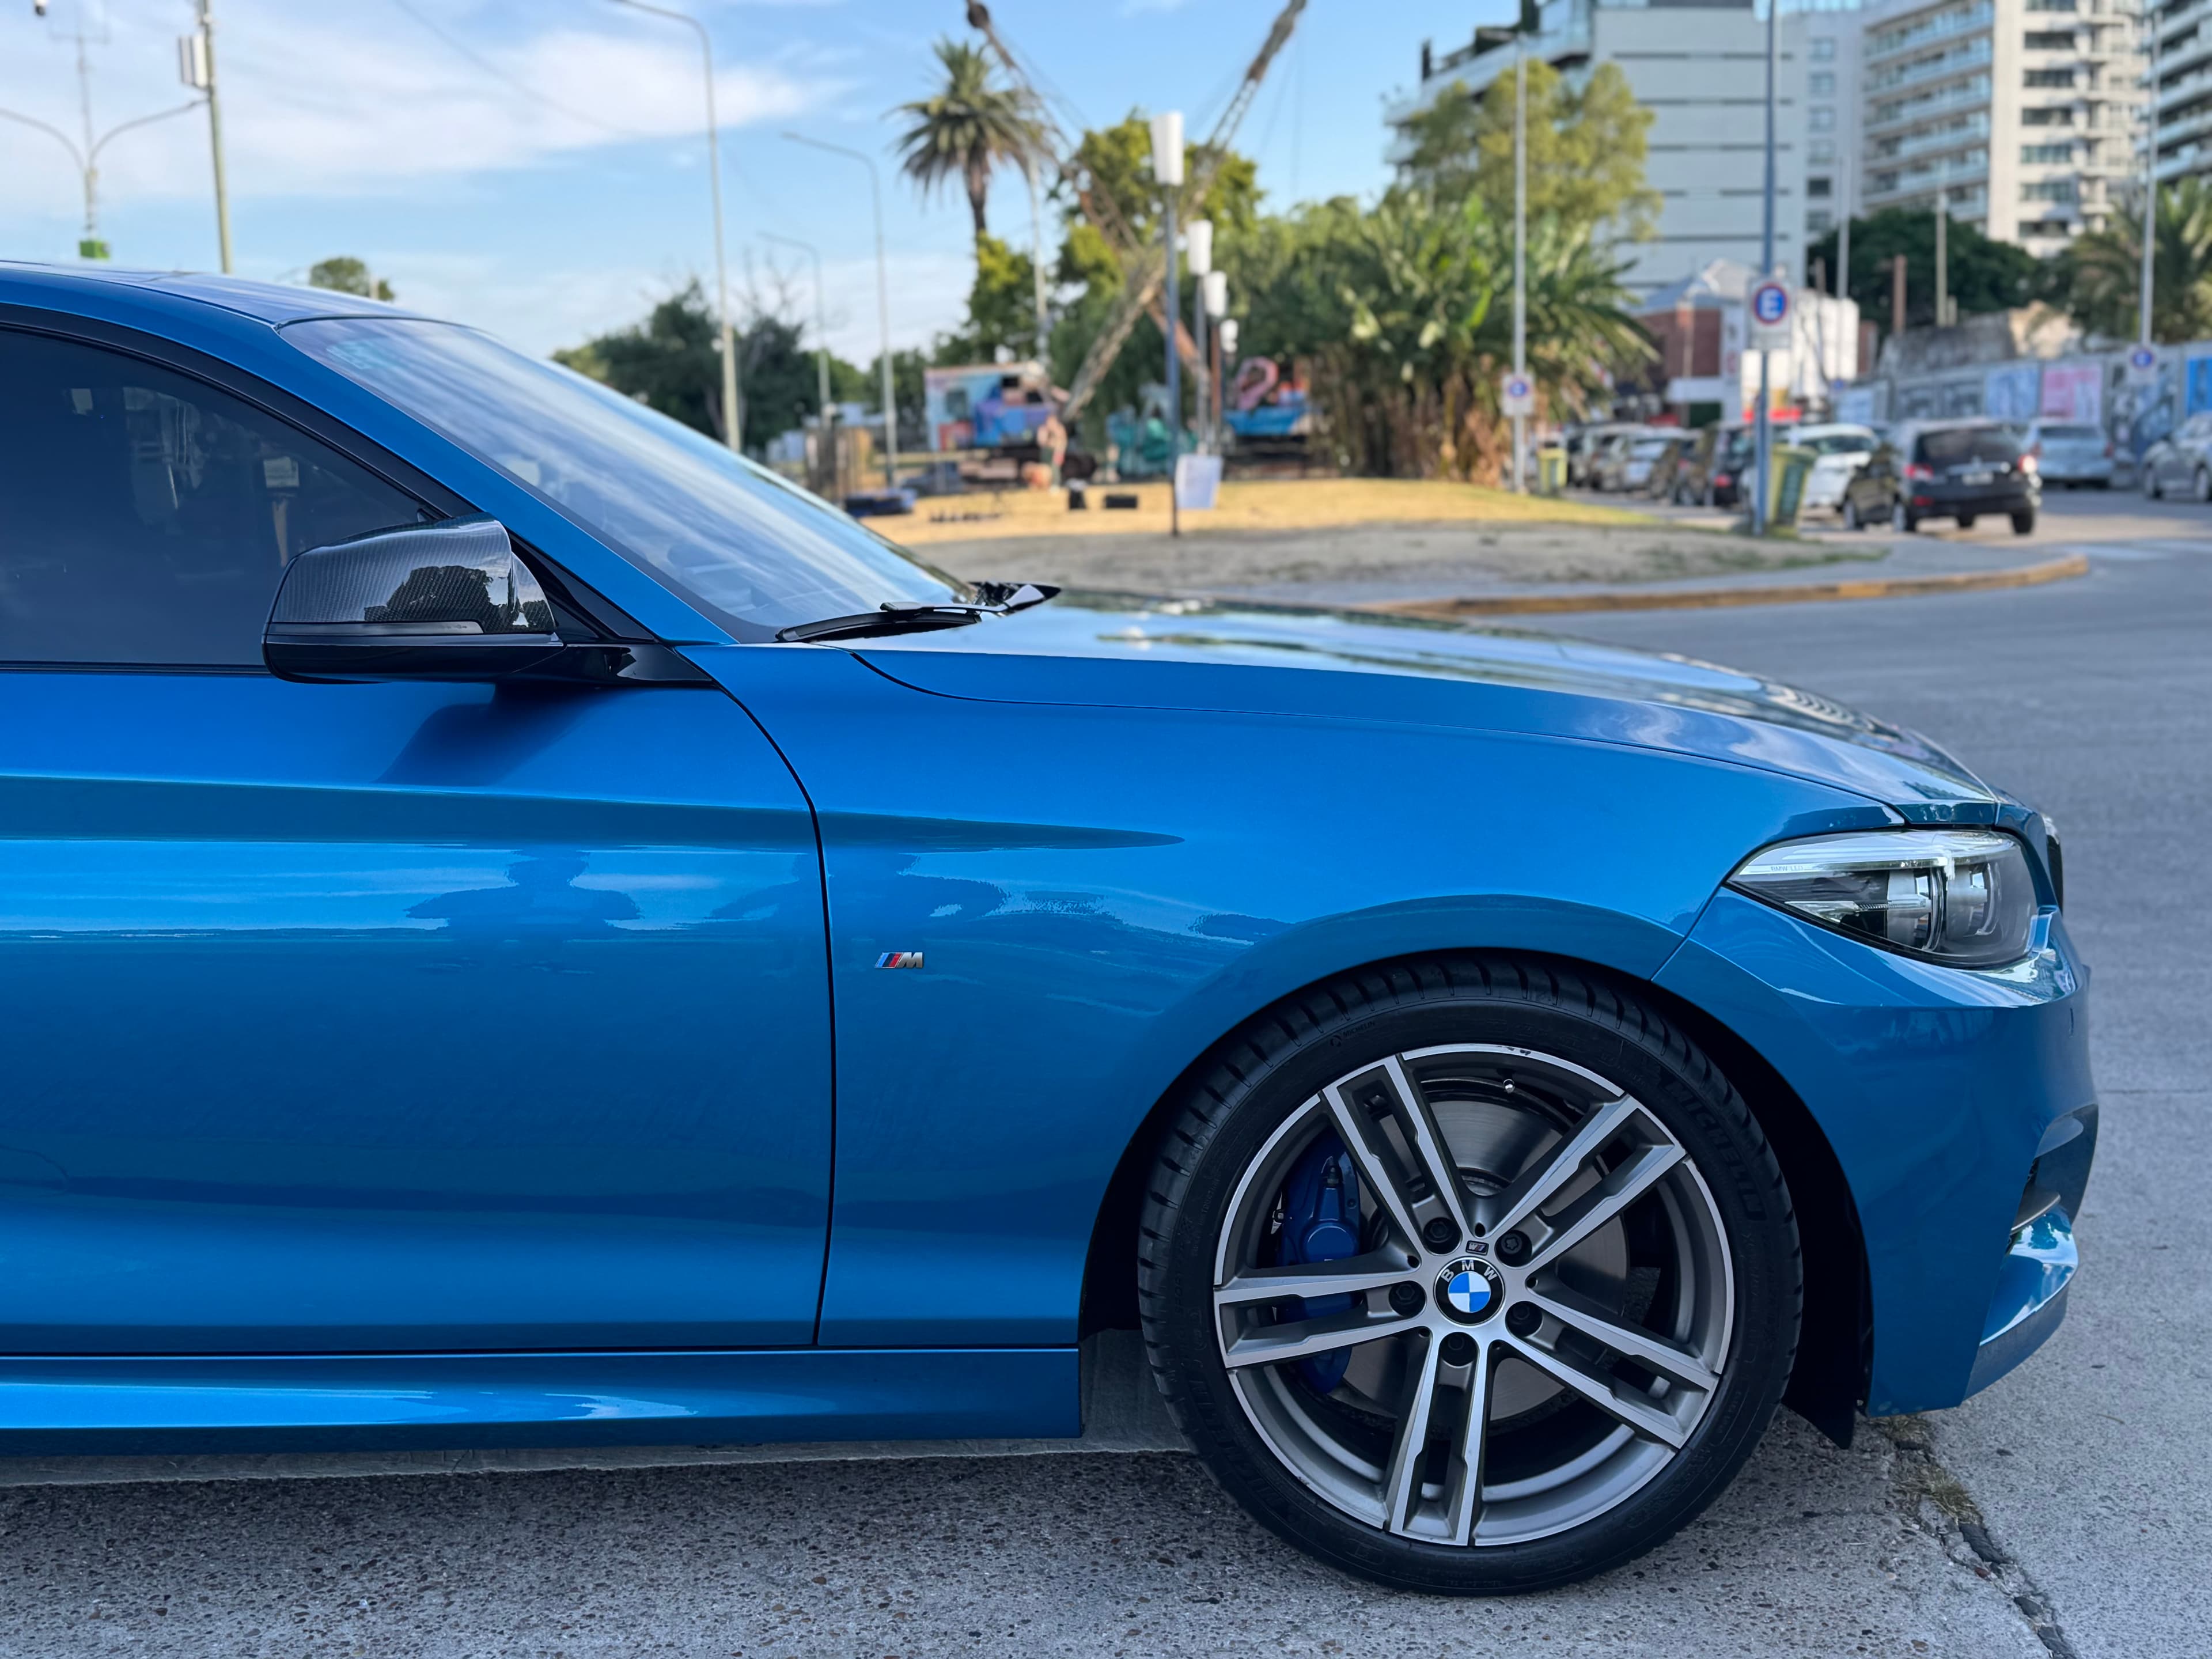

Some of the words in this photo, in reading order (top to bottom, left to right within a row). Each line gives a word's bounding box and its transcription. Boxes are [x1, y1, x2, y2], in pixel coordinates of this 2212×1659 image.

[1343, 1021, 1376, 1037] MICHELIN
[1665, 1079, 1762, 1218] MICHELIN
[1441, 1260, 1498, 1282] BMW
